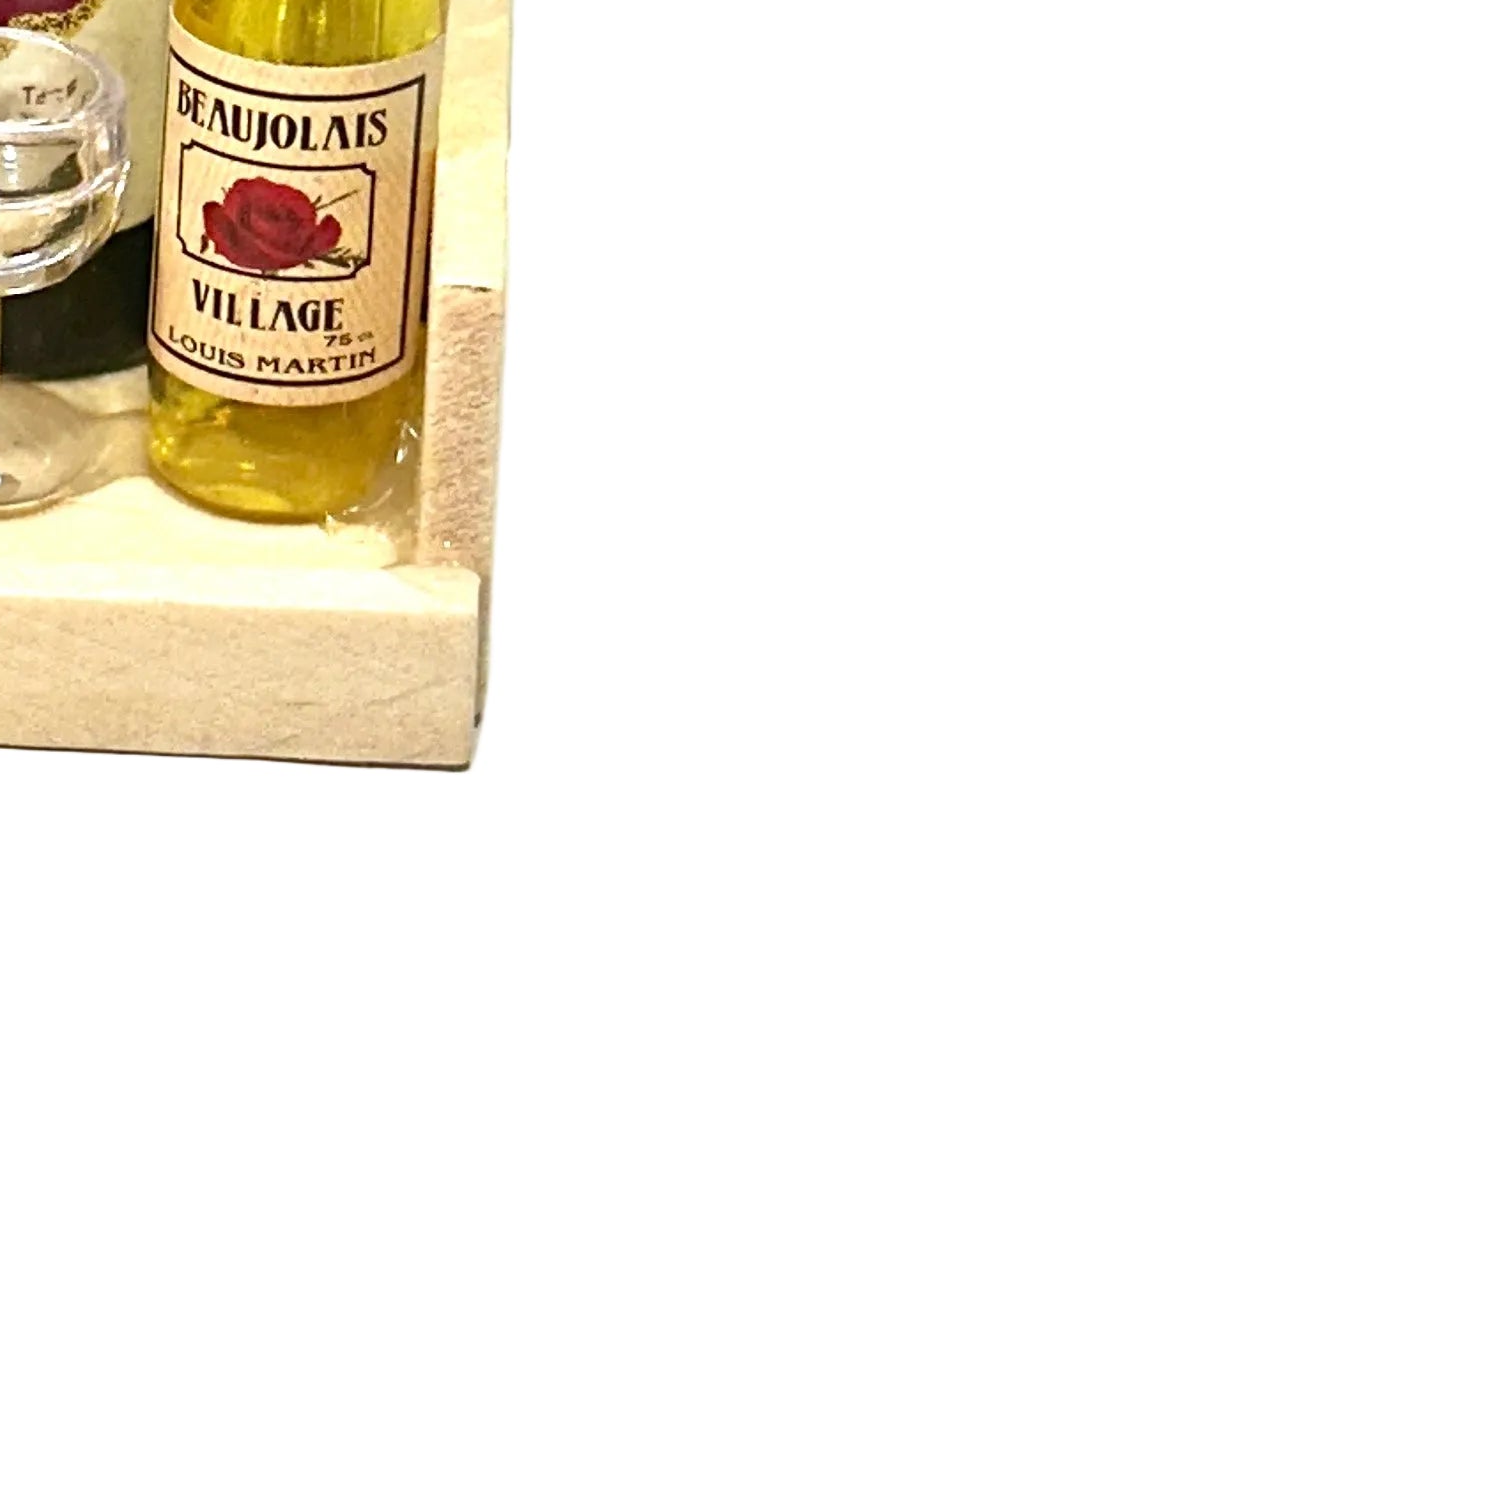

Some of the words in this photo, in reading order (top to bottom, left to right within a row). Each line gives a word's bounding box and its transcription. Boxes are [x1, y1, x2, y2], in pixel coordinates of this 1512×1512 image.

[176, 78, 389, 152] BEAUJOLAIS
[192, 278, 345, 333] VILLAGE
[168, 324, 246, 370] LOUIS
[256, 345, 377, 375] MARTIN
